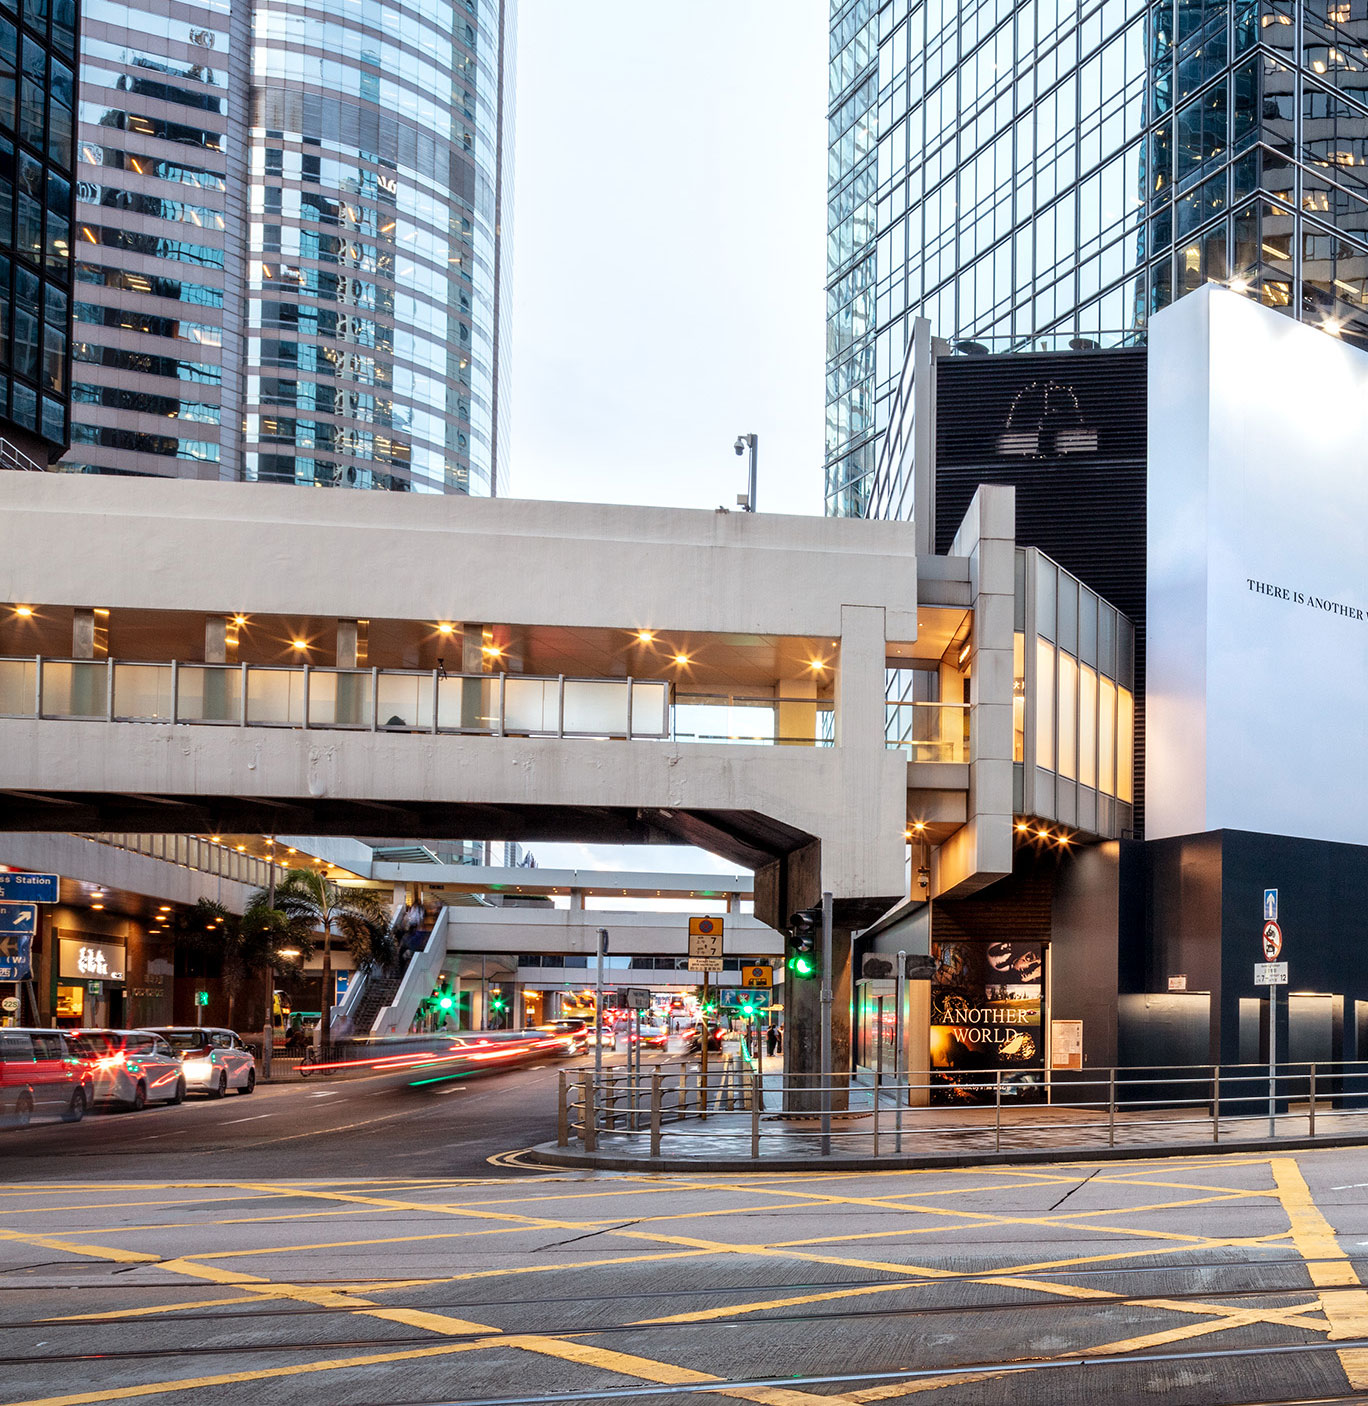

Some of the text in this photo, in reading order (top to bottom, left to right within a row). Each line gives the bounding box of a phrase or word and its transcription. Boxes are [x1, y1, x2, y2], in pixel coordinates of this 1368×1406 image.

[1247, 578, 1290, 601] THERE
[1293, 591, 1304, 604] IS
[1306, 596, 1363, 621] ANOTHER
[15, 876, 51, 885] Station
[942, 1008, 1029, 1024] ANOTHER
[953, 1028, 1018, 1043] WORLD
